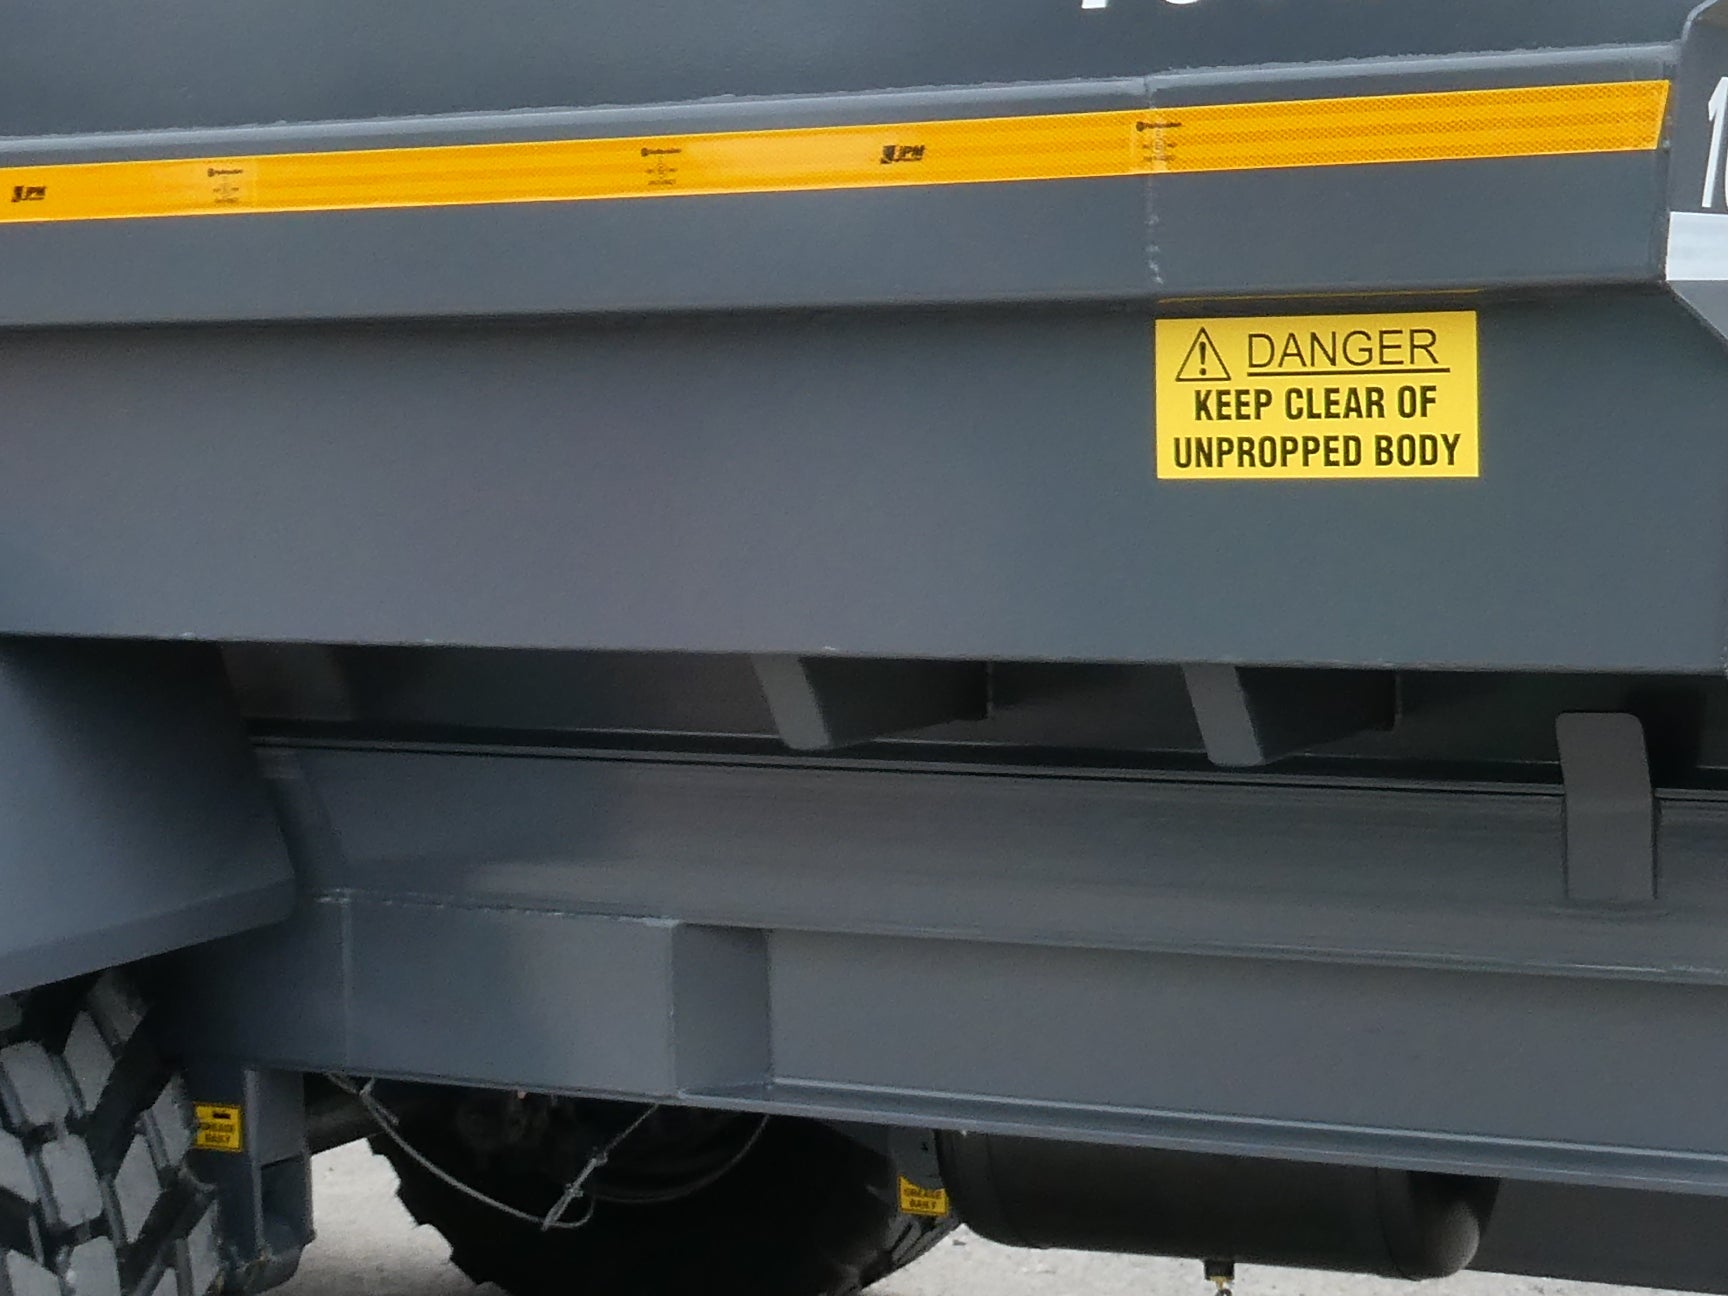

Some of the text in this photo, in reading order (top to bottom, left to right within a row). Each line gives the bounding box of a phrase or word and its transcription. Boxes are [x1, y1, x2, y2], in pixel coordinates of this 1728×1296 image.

[1248, 329, 1439, 369] DANGER
[1194, 385, 1437, 421] KEEP CLEAR OF
[1173, 433, 1461, 468] UNPROPPED BODY
